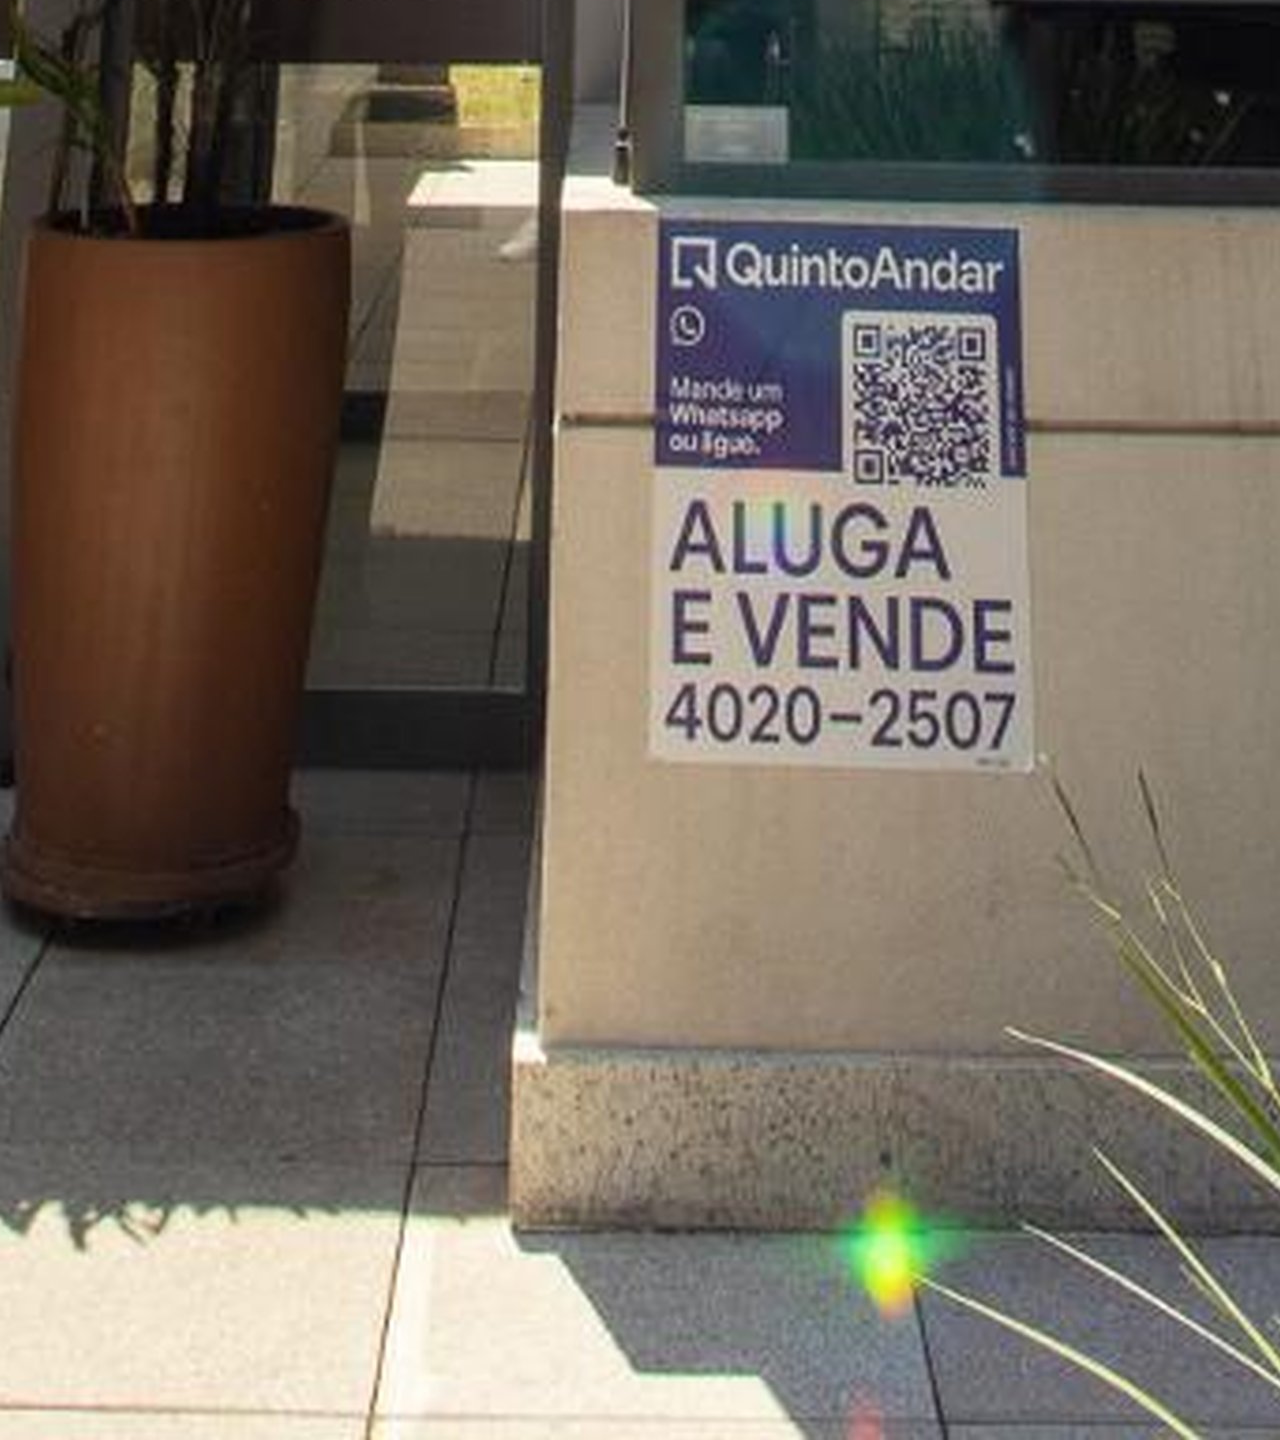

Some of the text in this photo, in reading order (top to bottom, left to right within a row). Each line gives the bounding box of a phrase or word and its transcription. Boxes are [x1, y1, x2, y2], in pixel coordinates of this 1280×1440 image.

[725, 241, 1005, 295] QuintoAndar
[669, 376, 784, 402] Mande um
[668, 432, 698, 452] ou
[669, 498, 952, 580] ALUGA
[671, 590, 1016, 674] E VENDE
[664, 682, 1017, 752] 4020-2507
